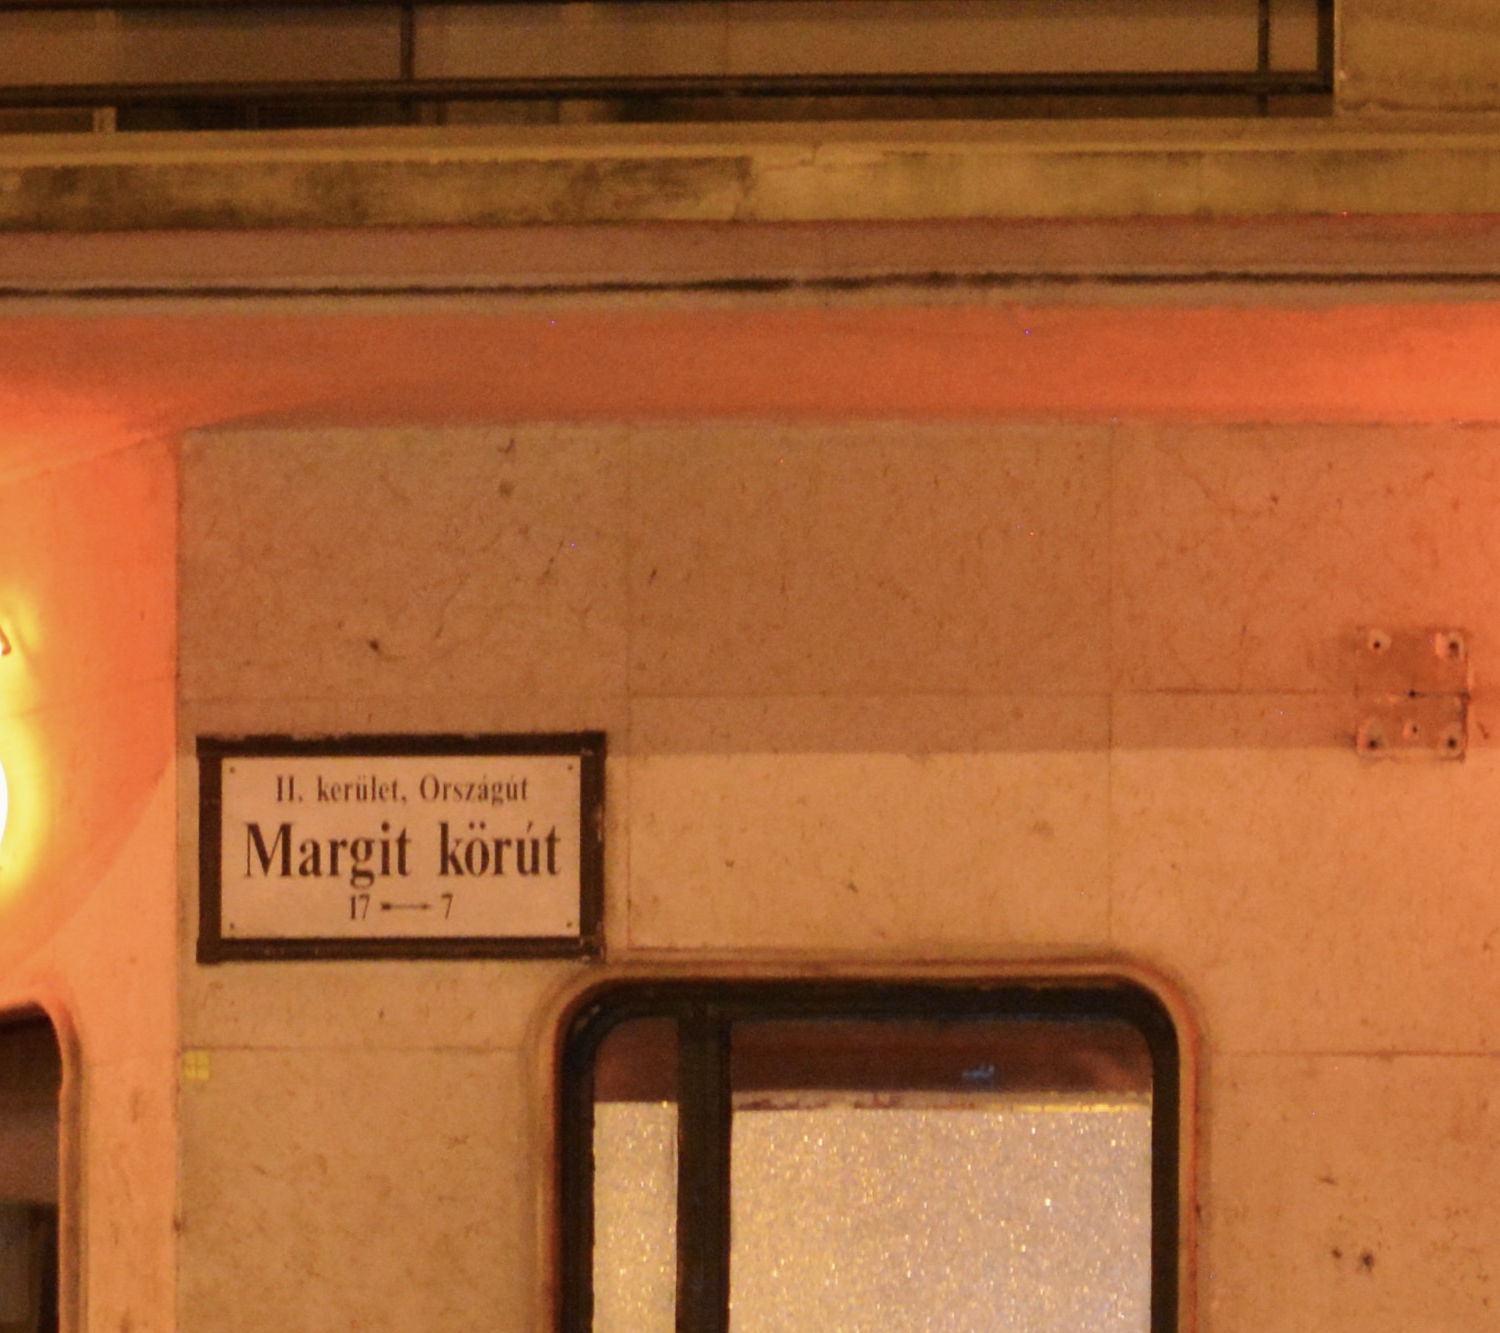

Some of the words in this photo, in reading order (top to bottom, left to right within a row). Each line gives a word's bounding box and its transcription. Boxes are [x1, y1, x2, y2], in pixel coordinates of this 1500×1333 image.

[275, 776, 304, 803] II.
[316, 773, 408, 805] kerület,
[419, 772, 529, 806] Országút
[244, 821, 411, 891] Margit
[438, 820, 562, 878] körút
[349, 894, 370, 921] 17
[440, 894, 454, 921] 7
